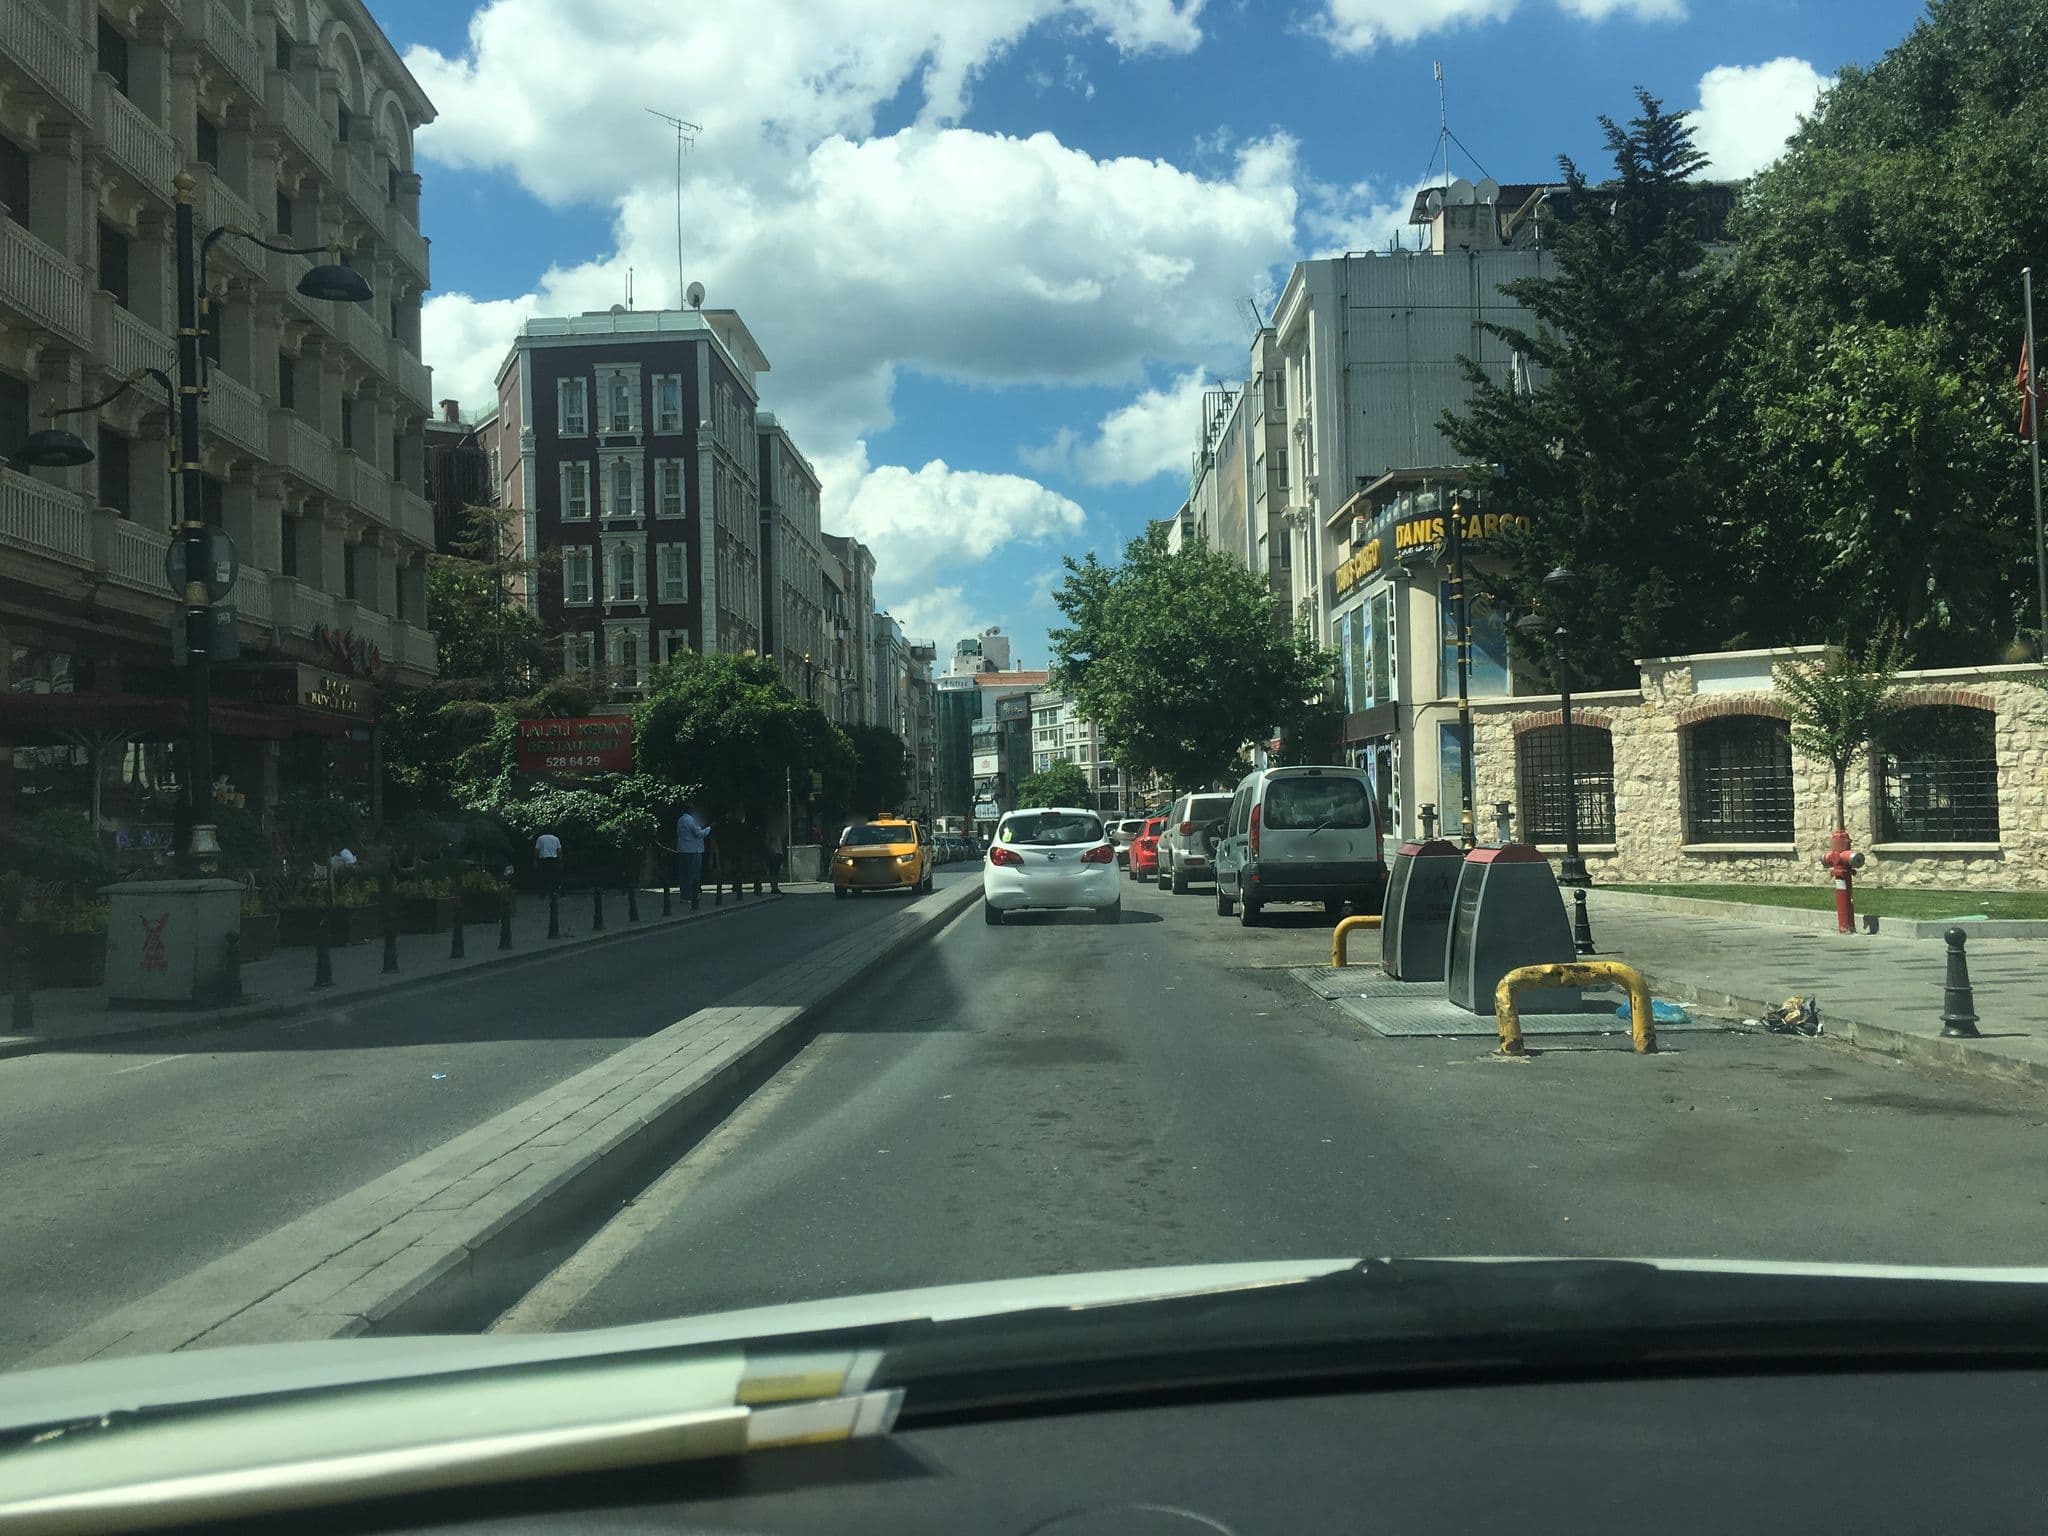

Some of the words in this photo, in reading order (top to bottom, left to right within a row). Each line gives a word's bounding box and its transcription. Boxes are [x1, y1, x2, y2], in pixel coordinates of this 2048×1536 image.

[1395, 517, 1445, 549] DANIS
[546, 757, 566, 768] 528
[569, 756, 584, 767] 64
[586, 755, 601, 766] 29
